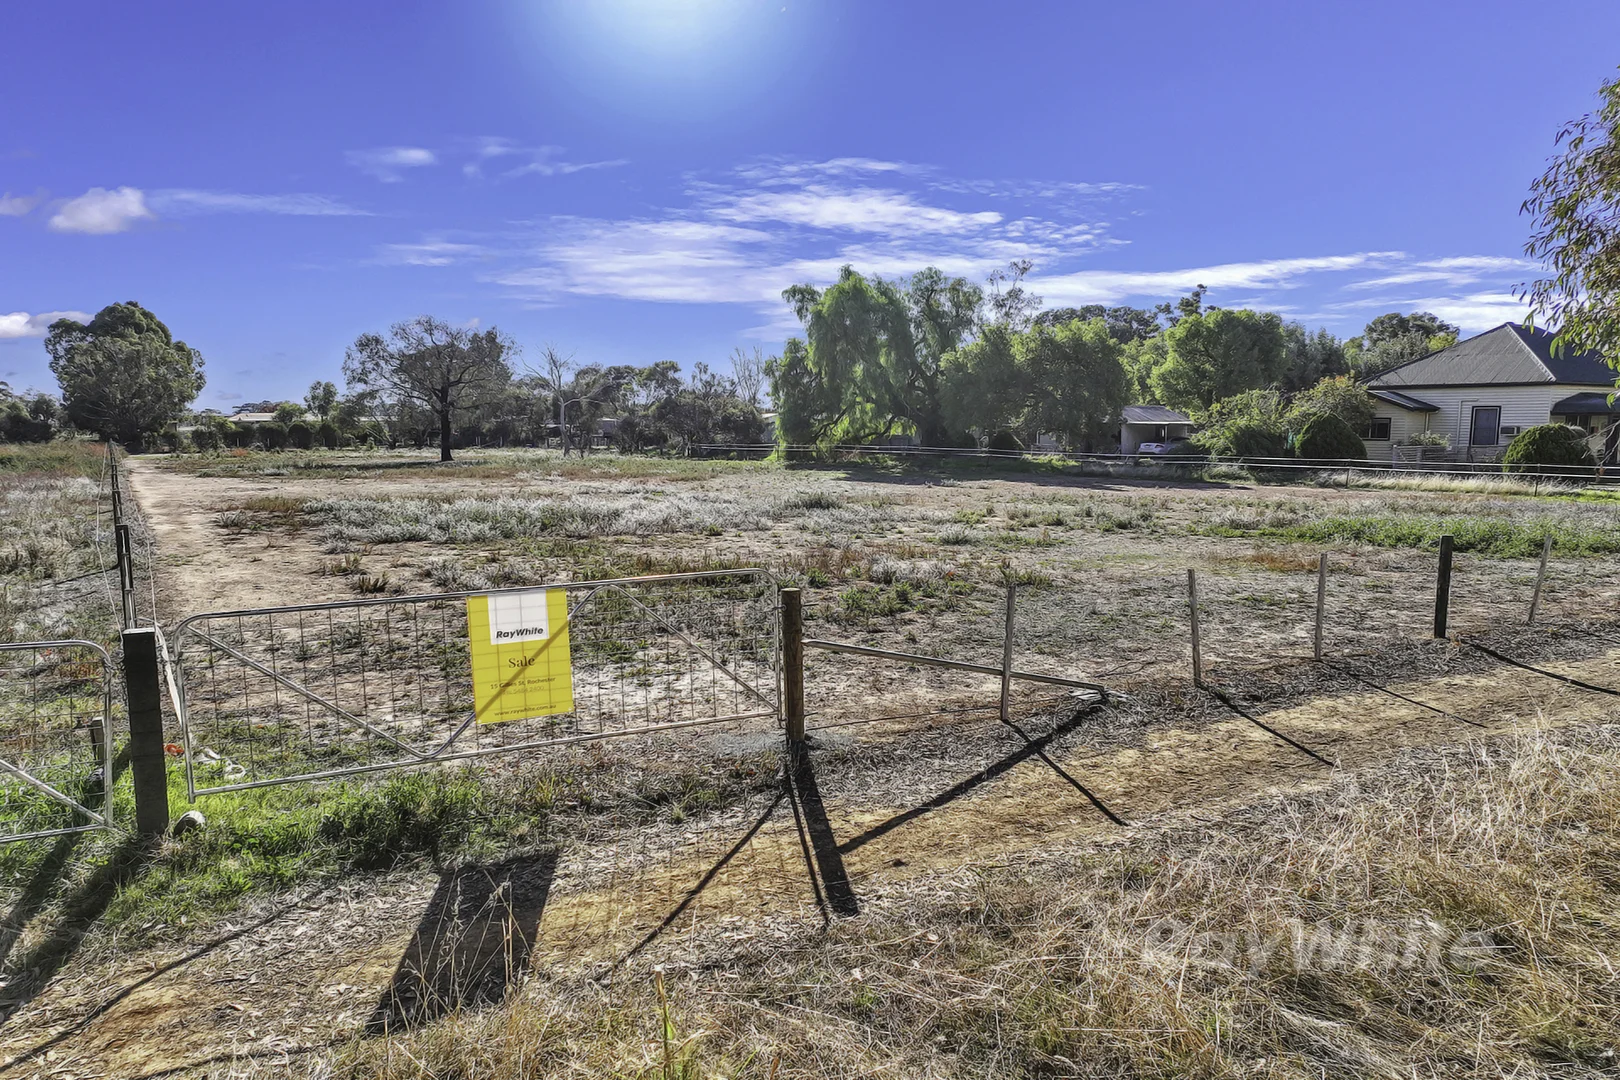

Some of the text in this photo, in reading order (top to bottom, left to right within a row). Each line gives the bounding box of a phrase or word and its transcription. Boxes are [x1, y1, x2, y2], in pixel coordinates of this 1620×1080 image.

[496, 627, 543, 638] RayWhite
[508, 655, 535, 669] Sale
[527, 677, 556, 685] Rochester
[495, 704, 556, 716] www.raywhite.com.au
